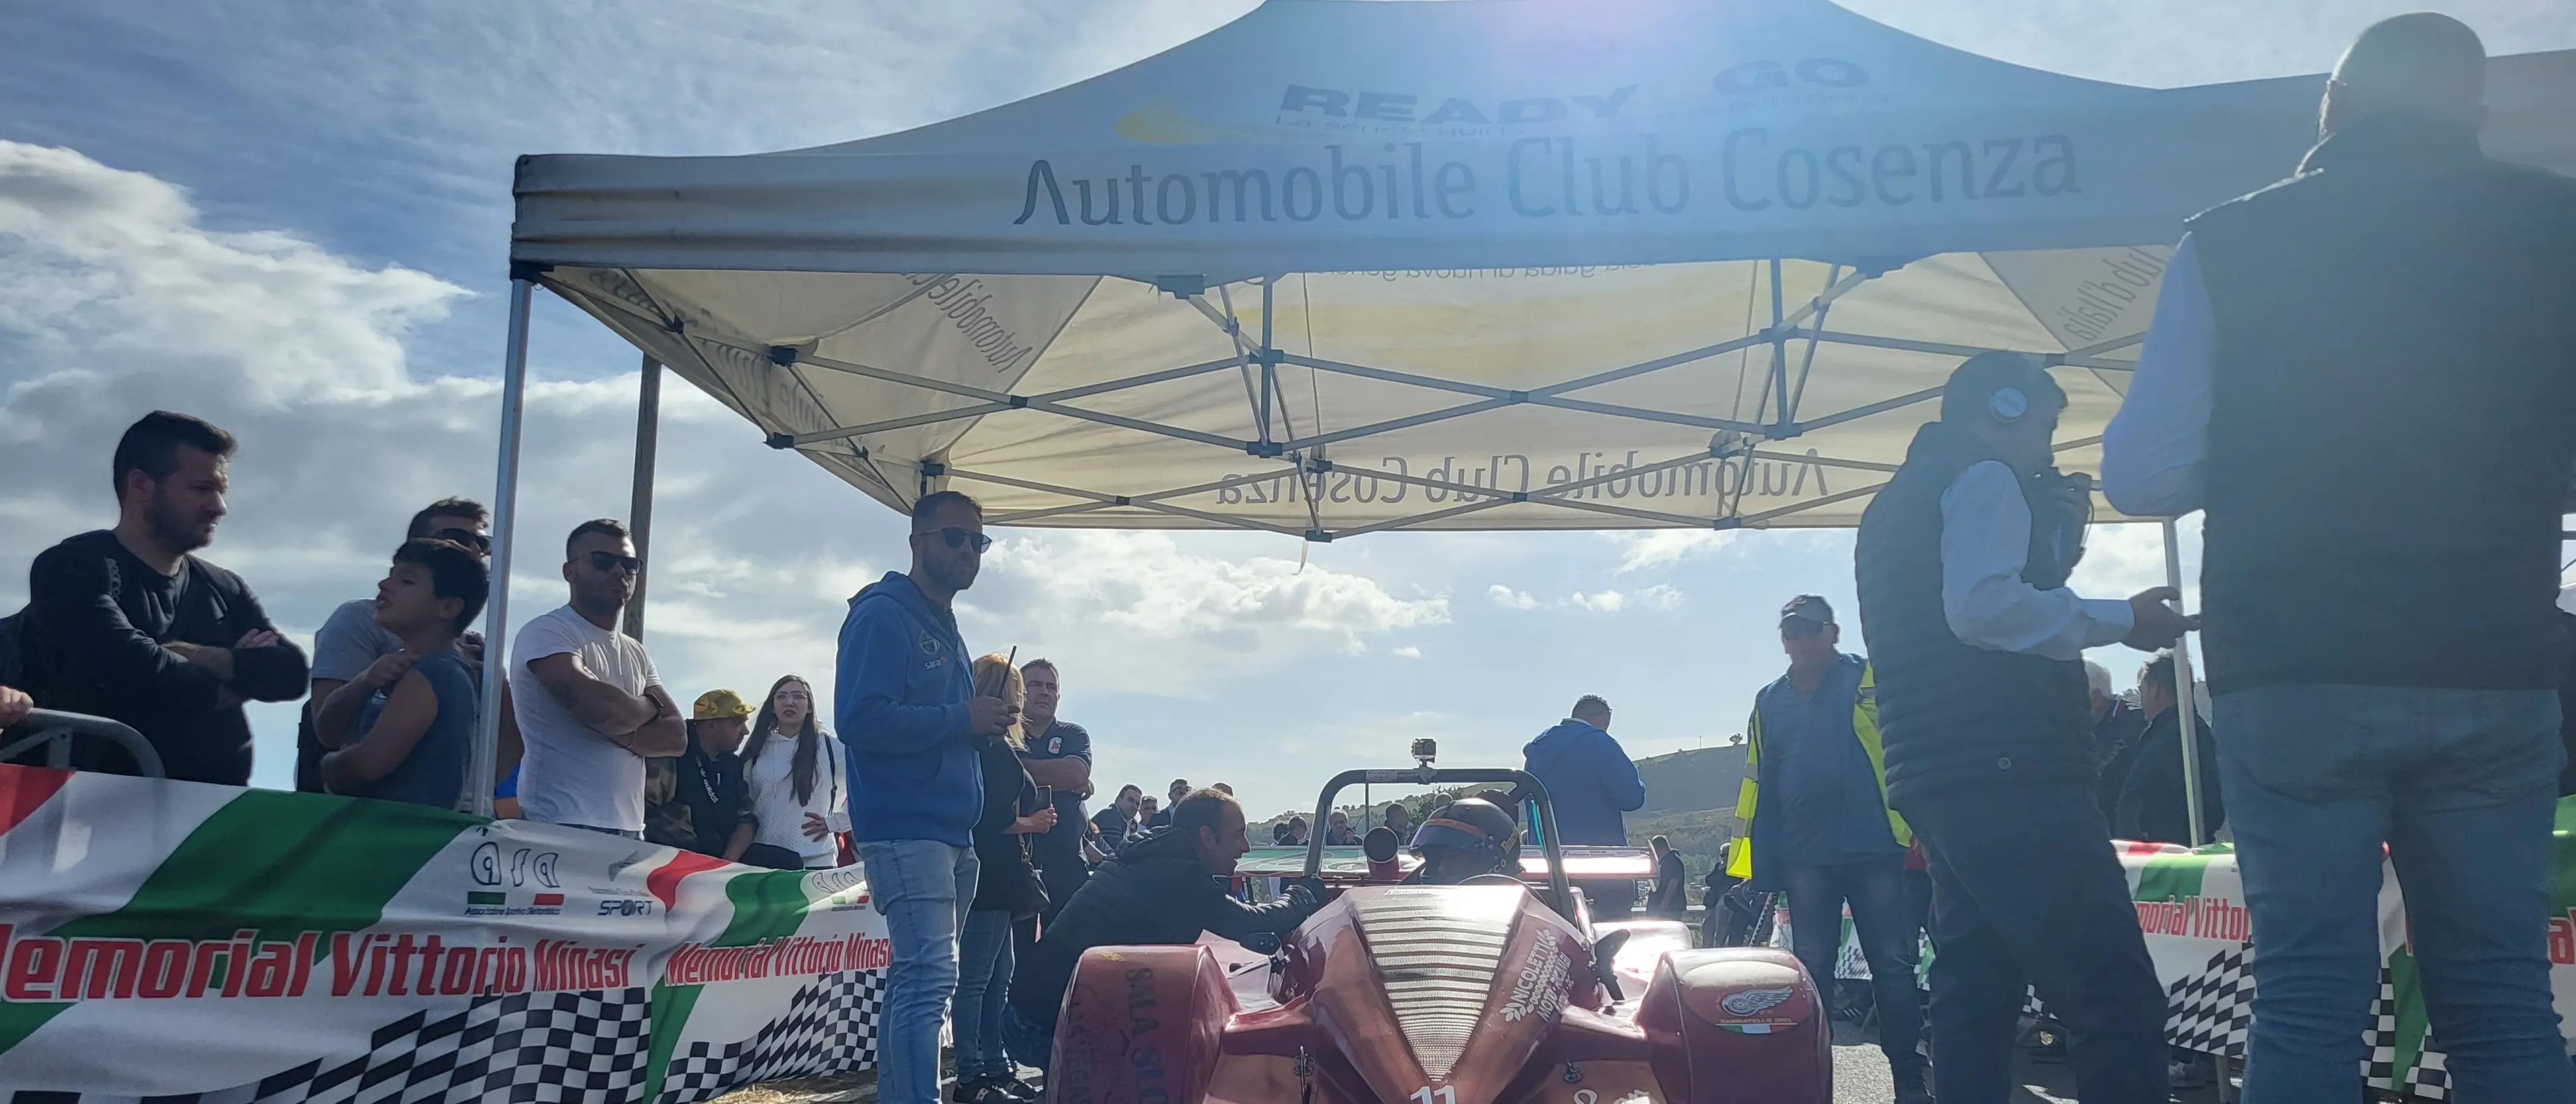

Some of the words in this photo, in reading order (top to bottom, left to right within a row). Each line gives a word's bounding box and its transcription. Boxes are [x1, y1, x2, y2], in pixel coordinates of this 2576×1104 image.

[1280, 83, 1640, 124] READY
[1713, 58, 1870, 94] GO
[1014, 142, 1477, 225] Automobile
[1507, 132, 1690, 219] Club
[1723, 128, 2082, 211] Cosenza
[924, 658, 942, 670] sara
[704, 779, 719, 803] adidas
[597, 899, 653, 917] SPORT
[2135, 897, 2192, 937] morial
[0, 929, 323, 999] emorial
[331, 934, 527, 997] Vittorio
[533, 939, 646, 993] Minasi
[664, 938, 779, 985] Memorial
[774, 934, 845, 977] Vittorio
[1510, 934, 1550, 1005] NICOLETTI
